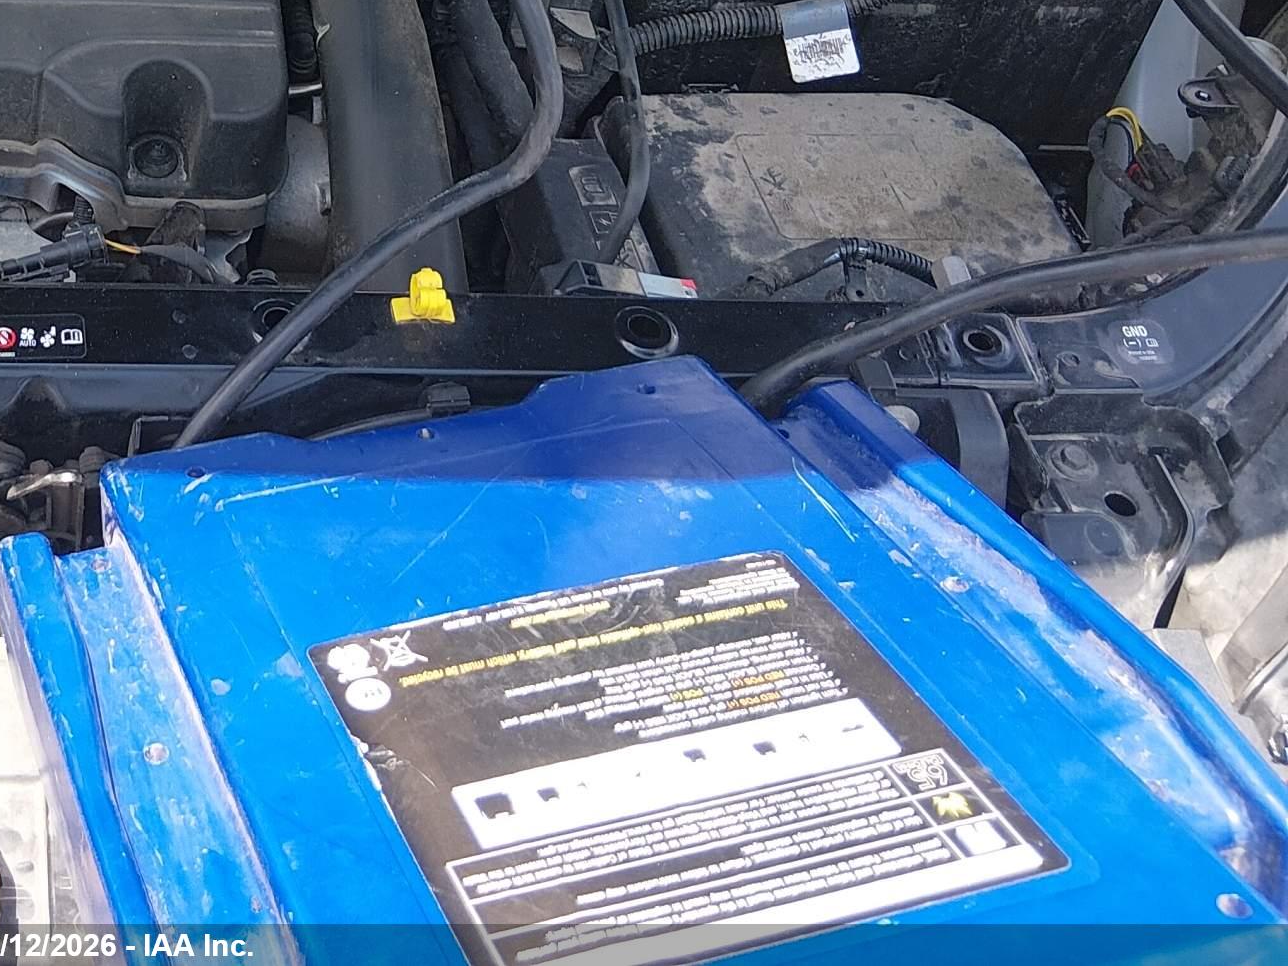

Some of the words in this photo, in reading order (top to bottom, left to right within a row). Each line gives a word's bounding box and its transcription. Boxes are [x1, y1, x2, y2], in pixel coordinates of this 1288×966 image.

[1122, 325, 1148, 338] GND
[19, 339, 37, 348] AUTO
[905, 763, 948, 790] 65
